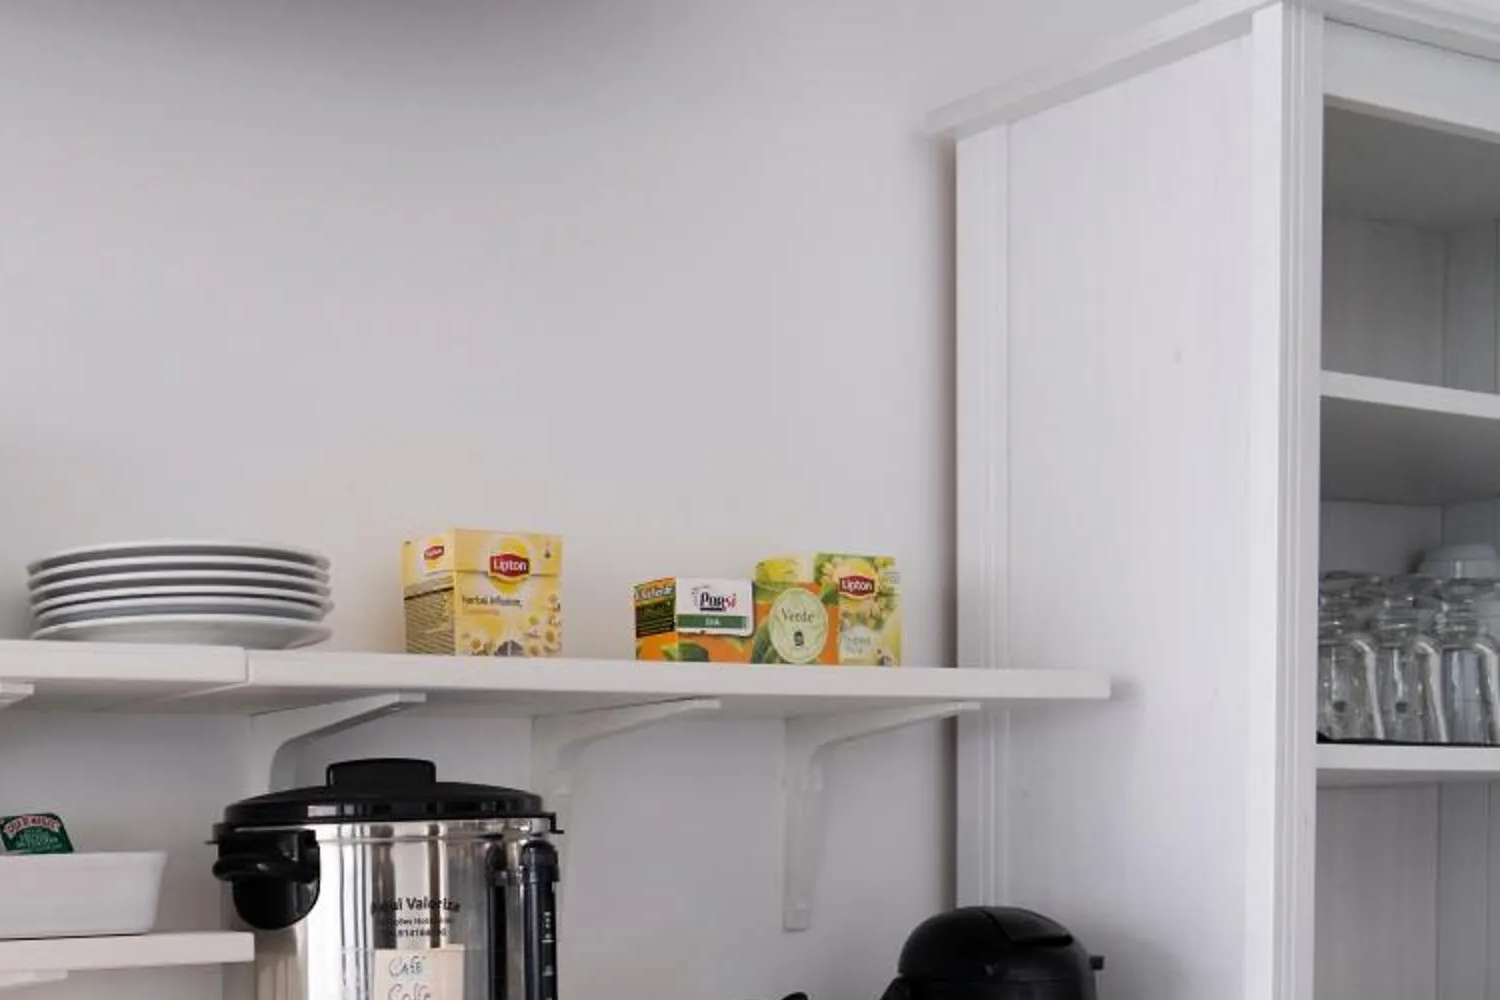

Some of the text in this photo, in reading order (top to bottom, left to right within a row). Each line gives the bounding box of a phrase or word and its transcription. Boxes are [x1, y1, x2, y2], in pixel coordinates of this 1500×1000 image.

[493, 558, 527, 574] Lipton
[842, 579, 873, 592] Lipton
[780, 607, 815, 624] Verde
